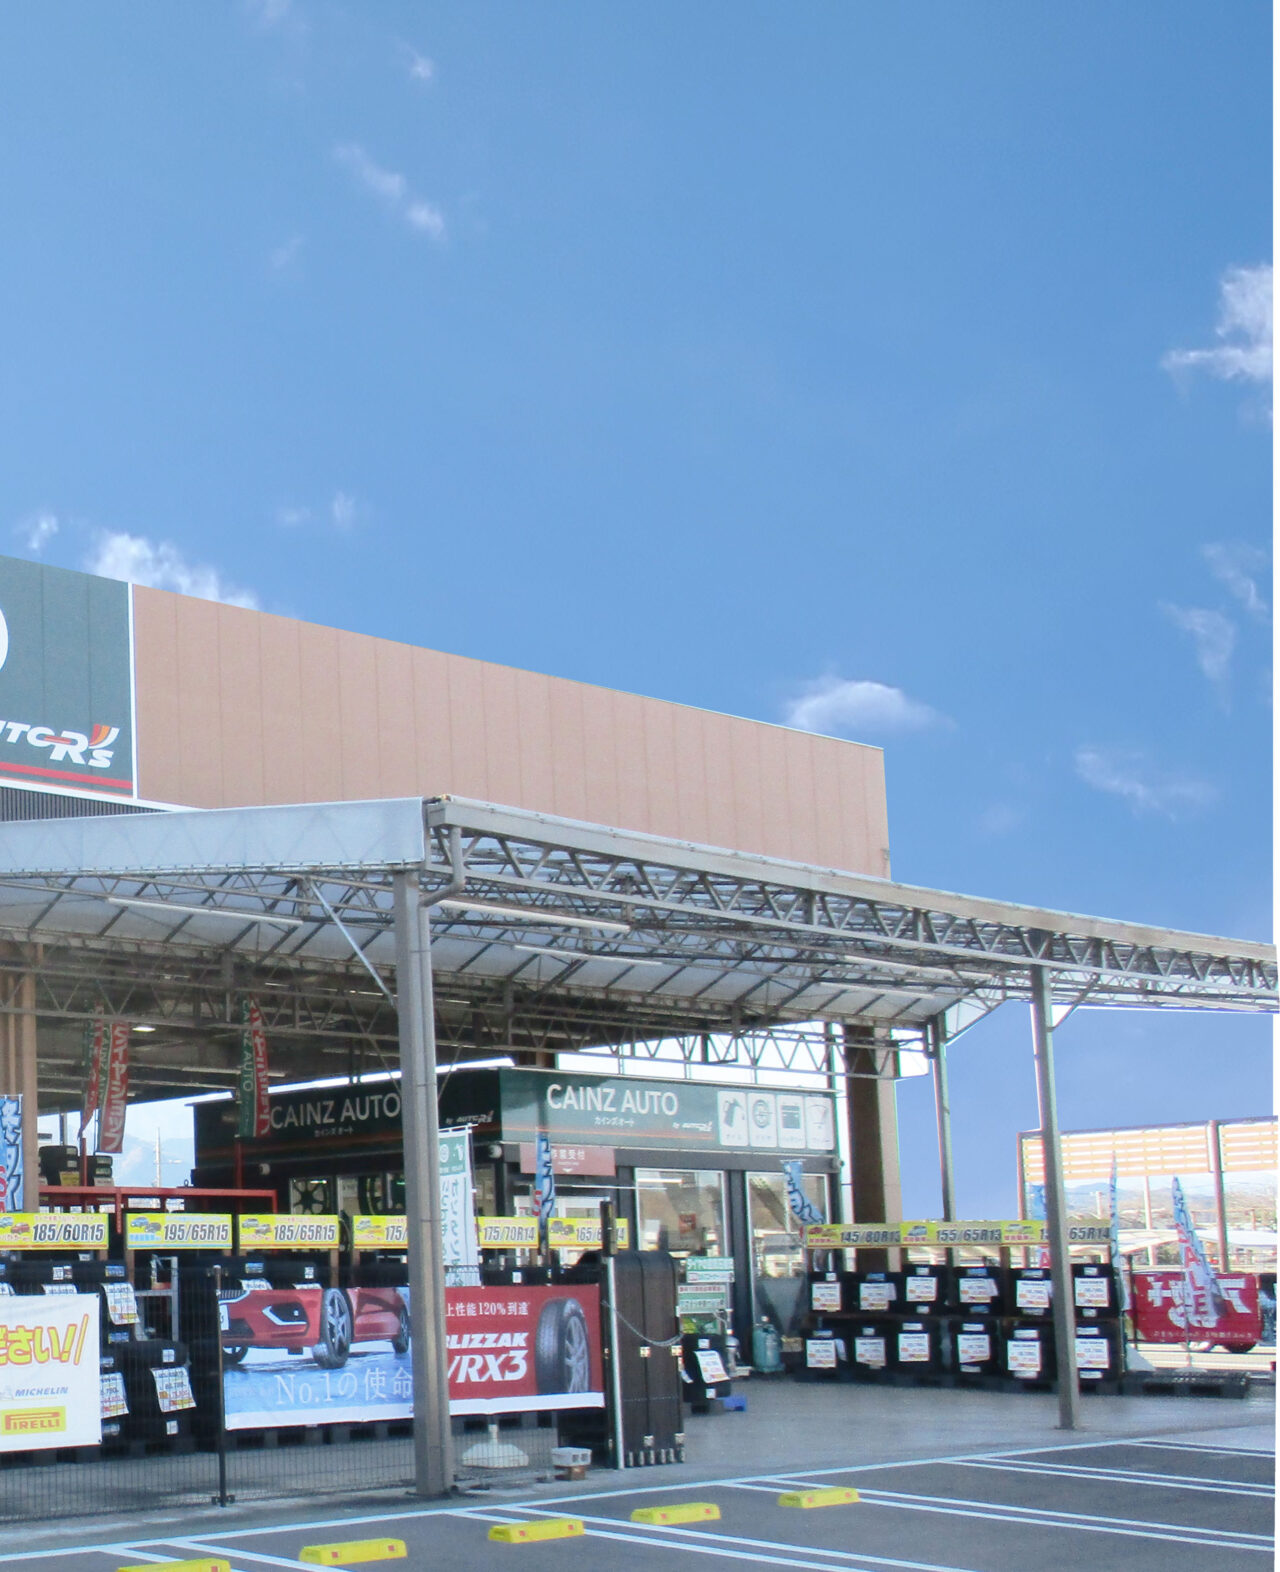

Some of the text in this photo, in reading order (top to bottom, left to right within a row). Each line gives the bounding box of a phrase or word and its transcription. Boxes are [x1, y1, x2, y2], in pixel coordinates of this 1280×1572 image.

[546, 1083, 679, 1117] CAINZ AUTO
[270, 1092, 401, 1129] CAINZ AUTO
[32, 1223, 105, 1242] 185/60R15
[163, 1223, 229, 1241] 195/65R15
[273, 1224, 336, 1241] 185/65R15
[483, 1226, 535, 1241] 175/70R14
[576, 1227, 626, 1241] 165/614
[936, 1228, 1001, 1242] 155/65R13
[14, 1386, 69, 1397] MICHELIN
[4, 1411, 61, 1431] PIRELLI
